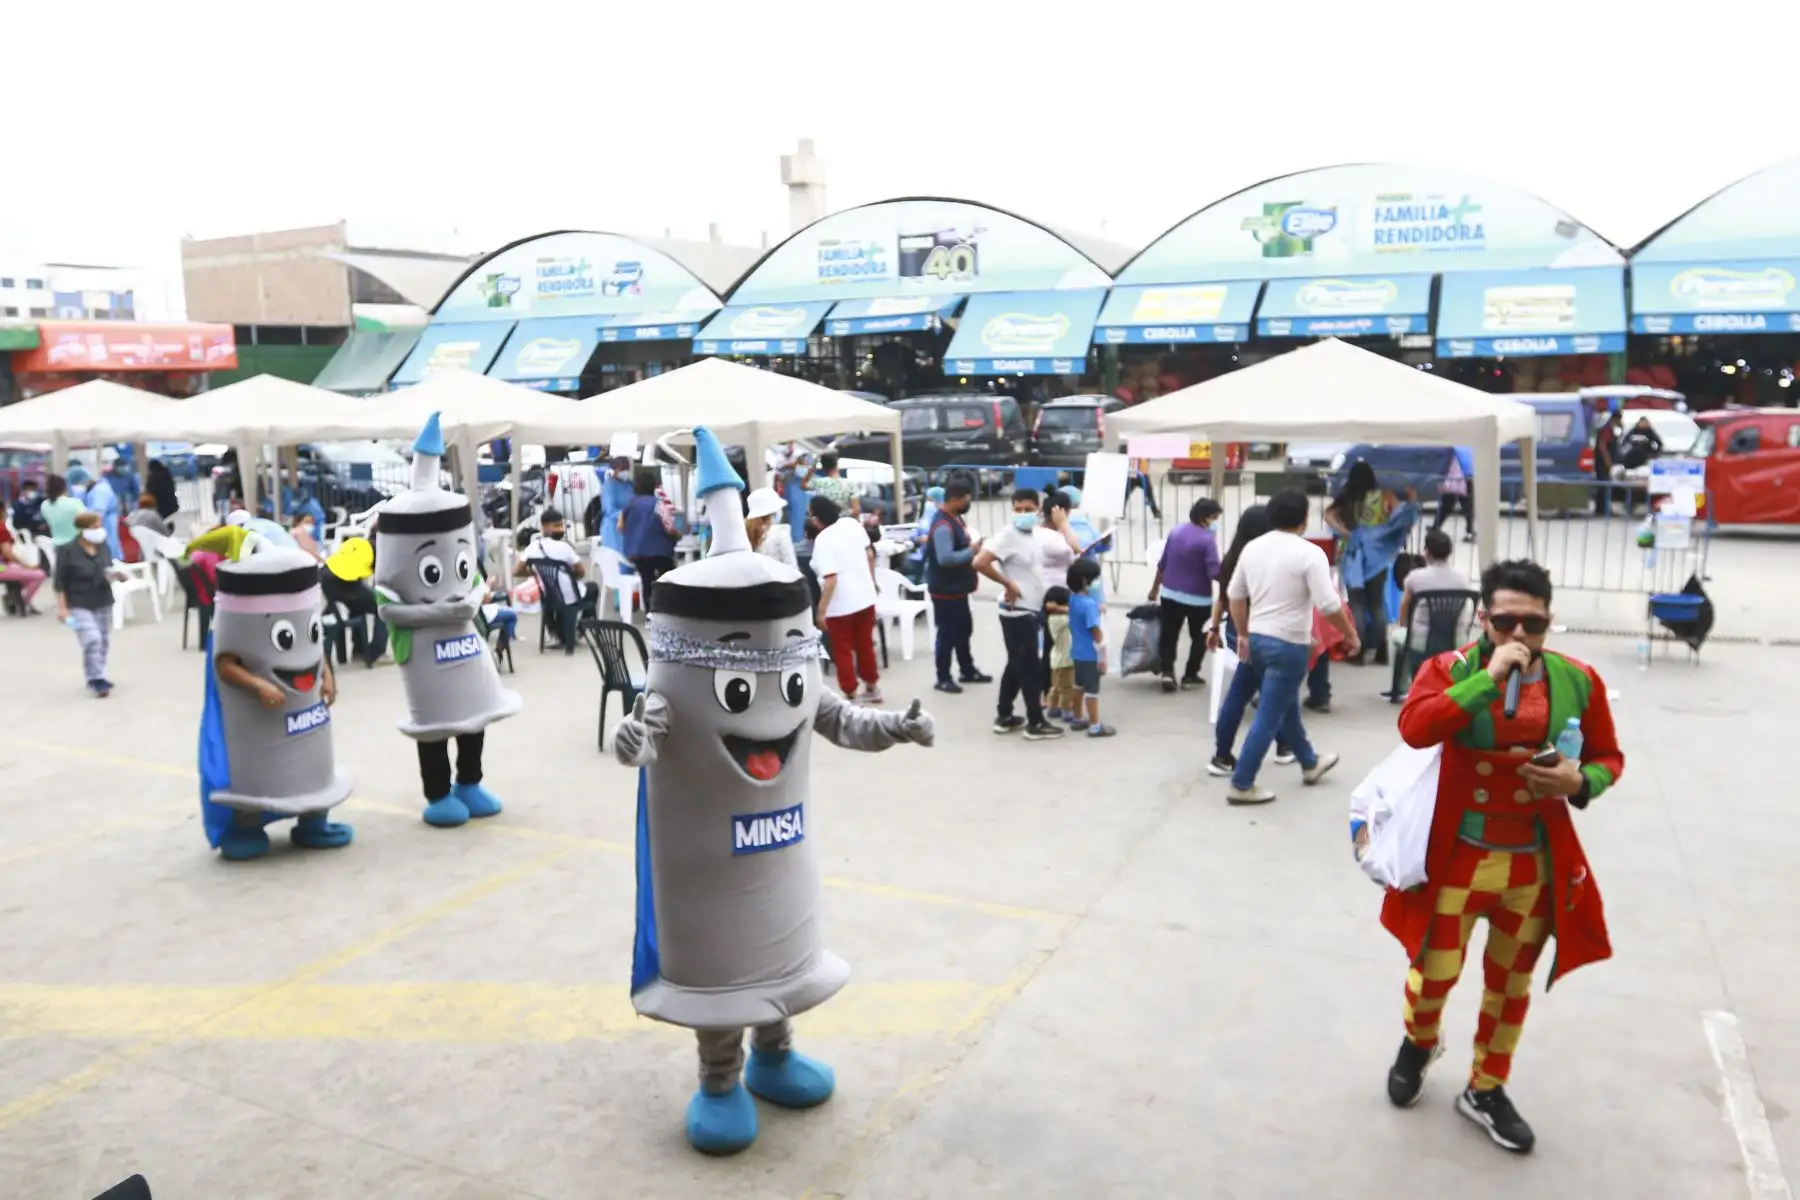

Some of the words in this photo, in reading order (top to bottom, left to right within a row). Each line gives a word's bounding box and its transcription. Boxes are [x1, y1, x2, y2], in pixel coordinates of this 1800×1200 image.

[1374, 204, 1449, 222] FAMILIA
[1374, 223, 1485, 245] RENDIDORA
[818, 247, 865, 262] FAMILIA
[923, 245, 975, 280] 40
[818, 261, 888, 278] RENDIDORA
[1693, 314, 1767, 331] CEBOLLA
[1142, 326, 1197, 340] CEBOLLA
[1492, 337, 1558, 353] CEBOLLA
[435, 635, 480, 660] MINSA
[735, 809, 802, 849] MINSA
